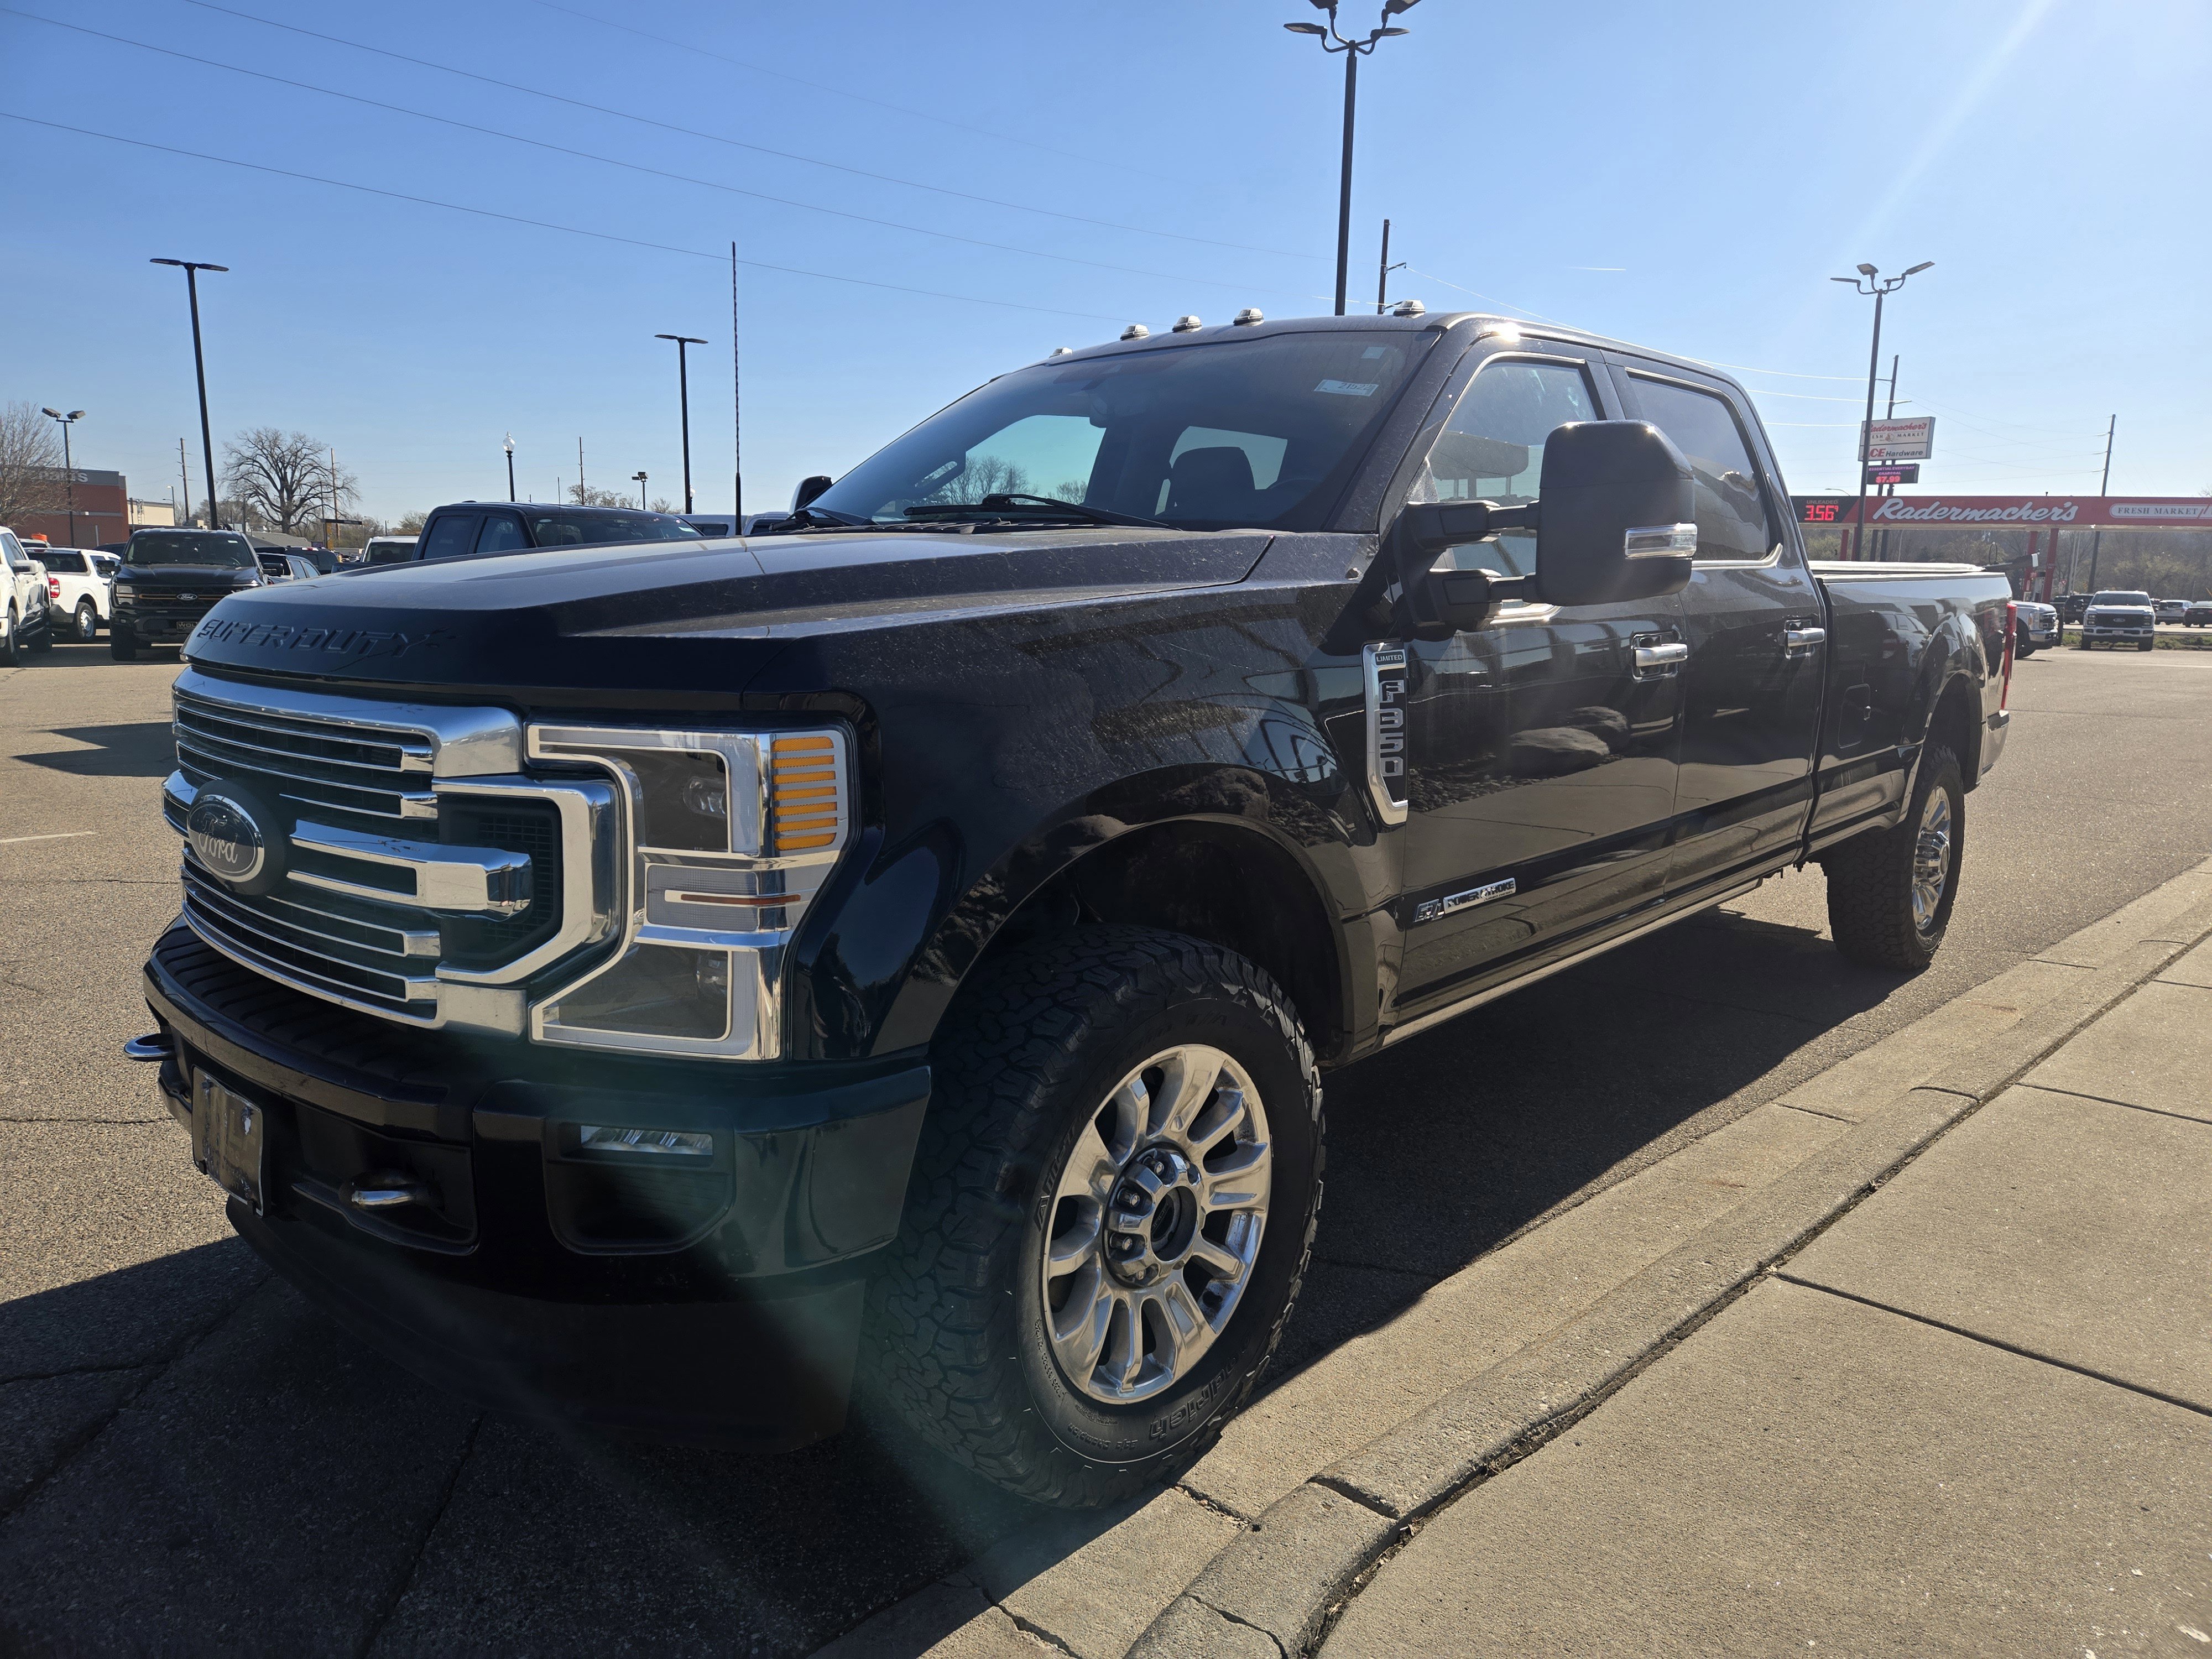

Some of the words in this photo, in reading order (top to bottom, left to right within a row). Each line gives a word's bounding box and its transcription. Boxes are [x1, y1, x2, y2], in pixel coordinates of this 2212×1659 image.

[1866, 448, 1886, 458] CE
[1875, 475, 1901, 484] $7.99
[1872, 498, 2079, 521] Radermacher's
[197, 619, 294, 649] SUPER
[290, 627, 430, 658] DUTY
[198, 811, 238, 864] Ford
